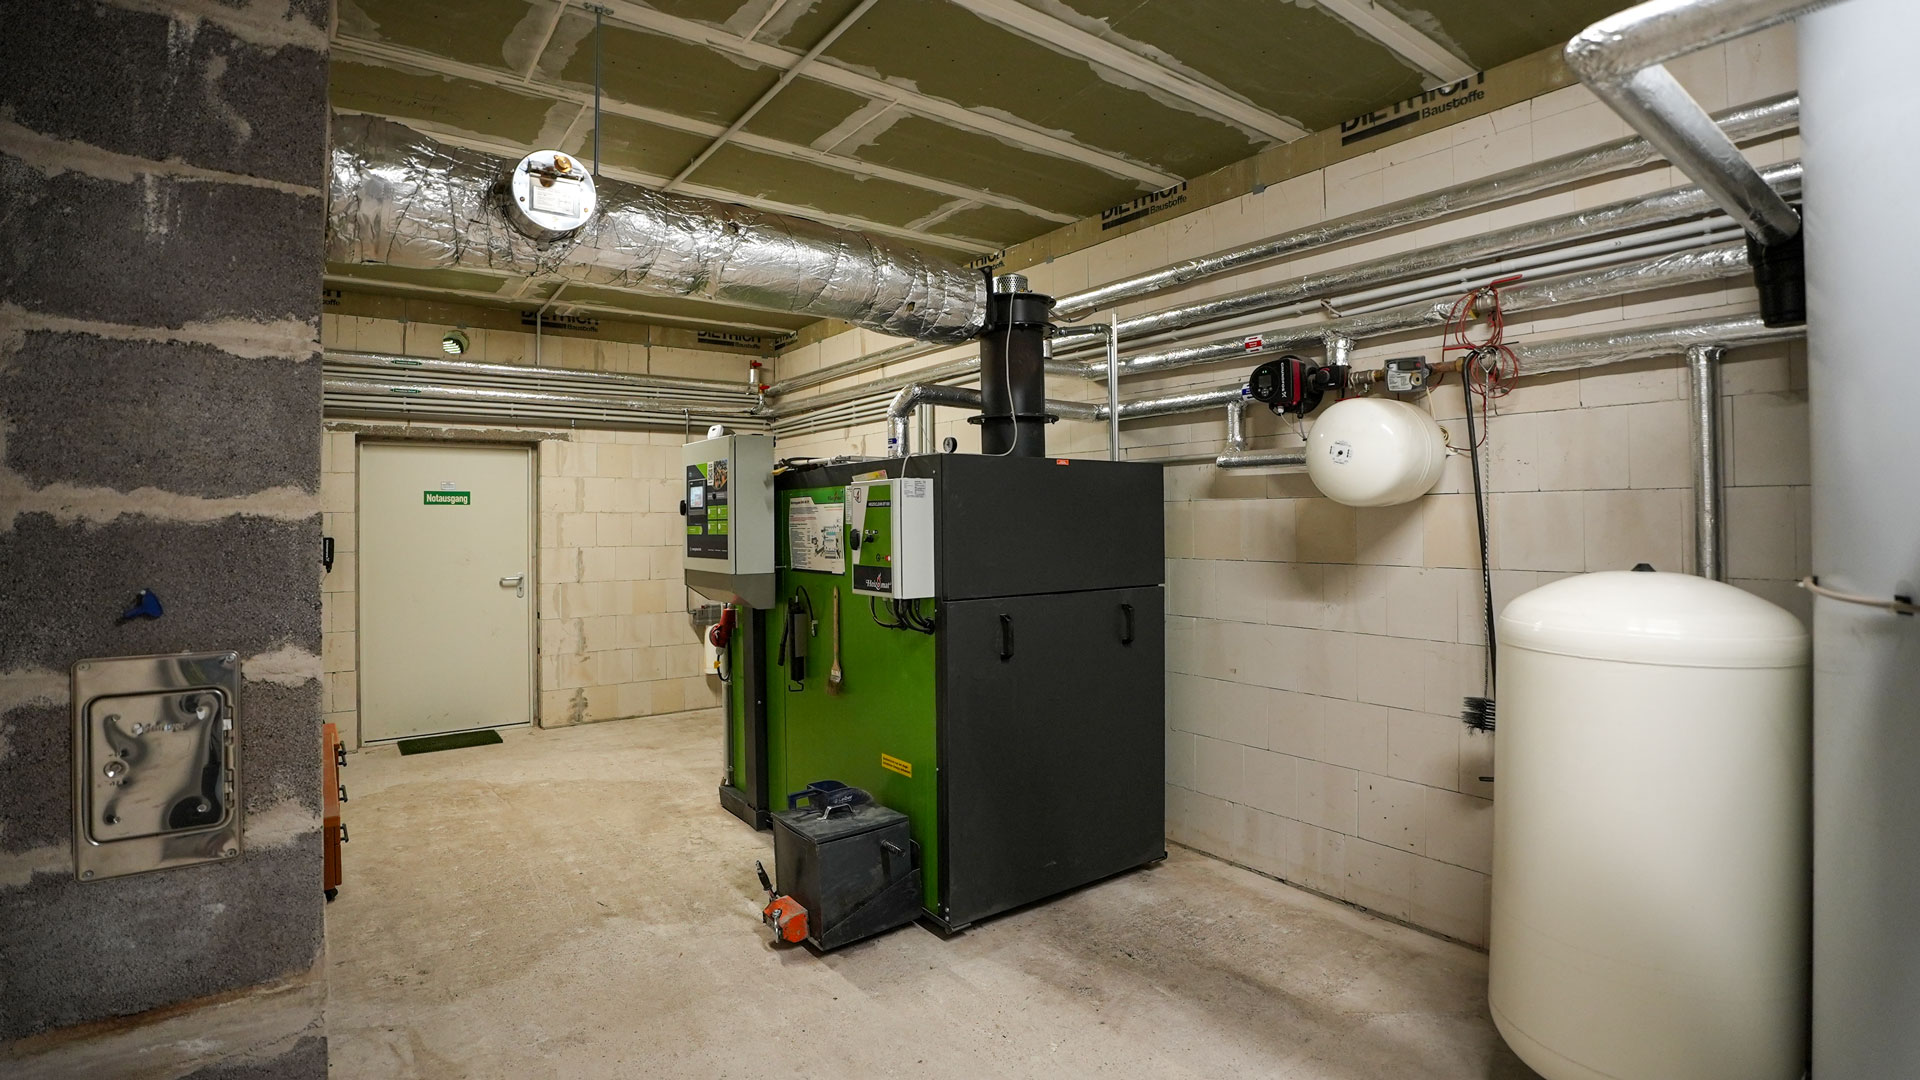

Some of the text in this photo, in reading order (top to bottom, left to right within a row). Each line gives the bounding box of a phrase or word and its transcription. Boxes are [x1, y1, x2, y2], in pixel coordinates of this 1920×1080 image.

[1422, 88, 1485, 119] Baustoffe
[1150, 195, 1187, 214] Baustoffe
[426, 493, 468, 505] Notausgang
